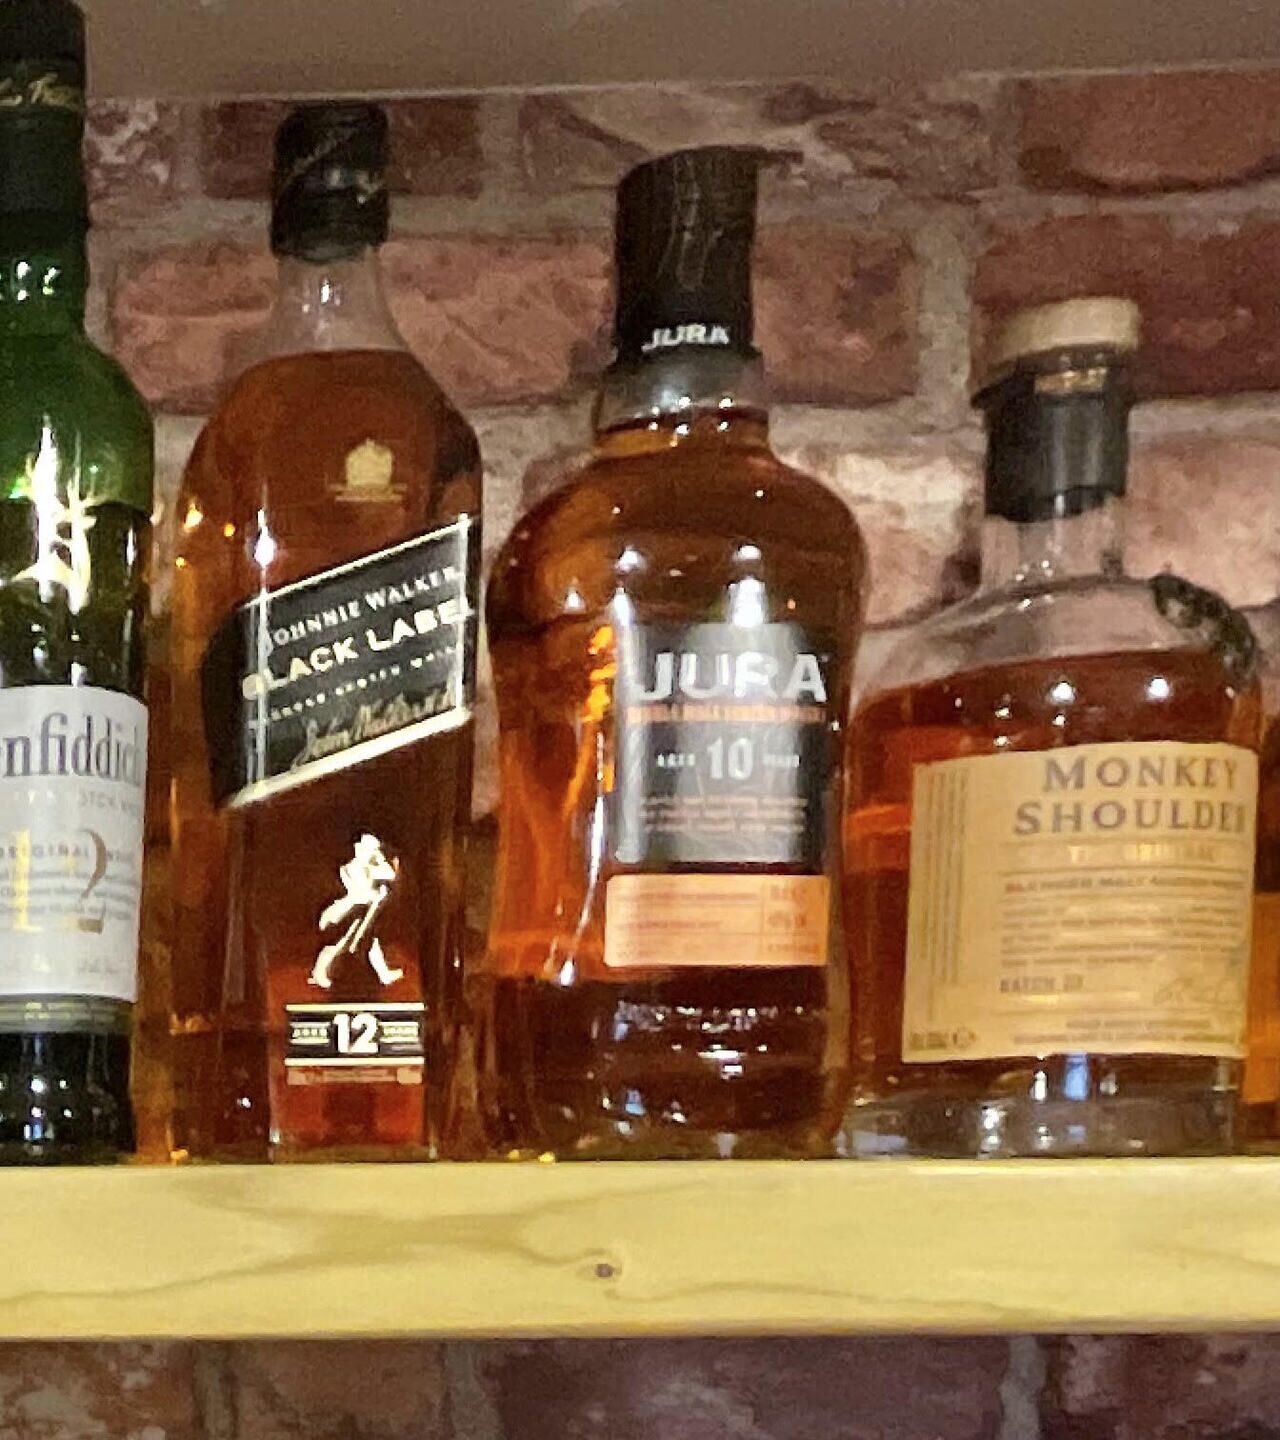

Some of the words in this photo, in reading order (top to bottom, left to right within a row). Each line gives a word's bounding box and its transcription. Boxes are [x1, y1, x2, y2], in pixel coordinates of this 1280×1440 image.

[641, 322, 730, 353] JURA
[635, 651, 829, 703] JURA
[706, 735, 754, 781] 10
[1042, 754, 1237, 793] MONKEY
[333, 1011, 379, 1053] 12
